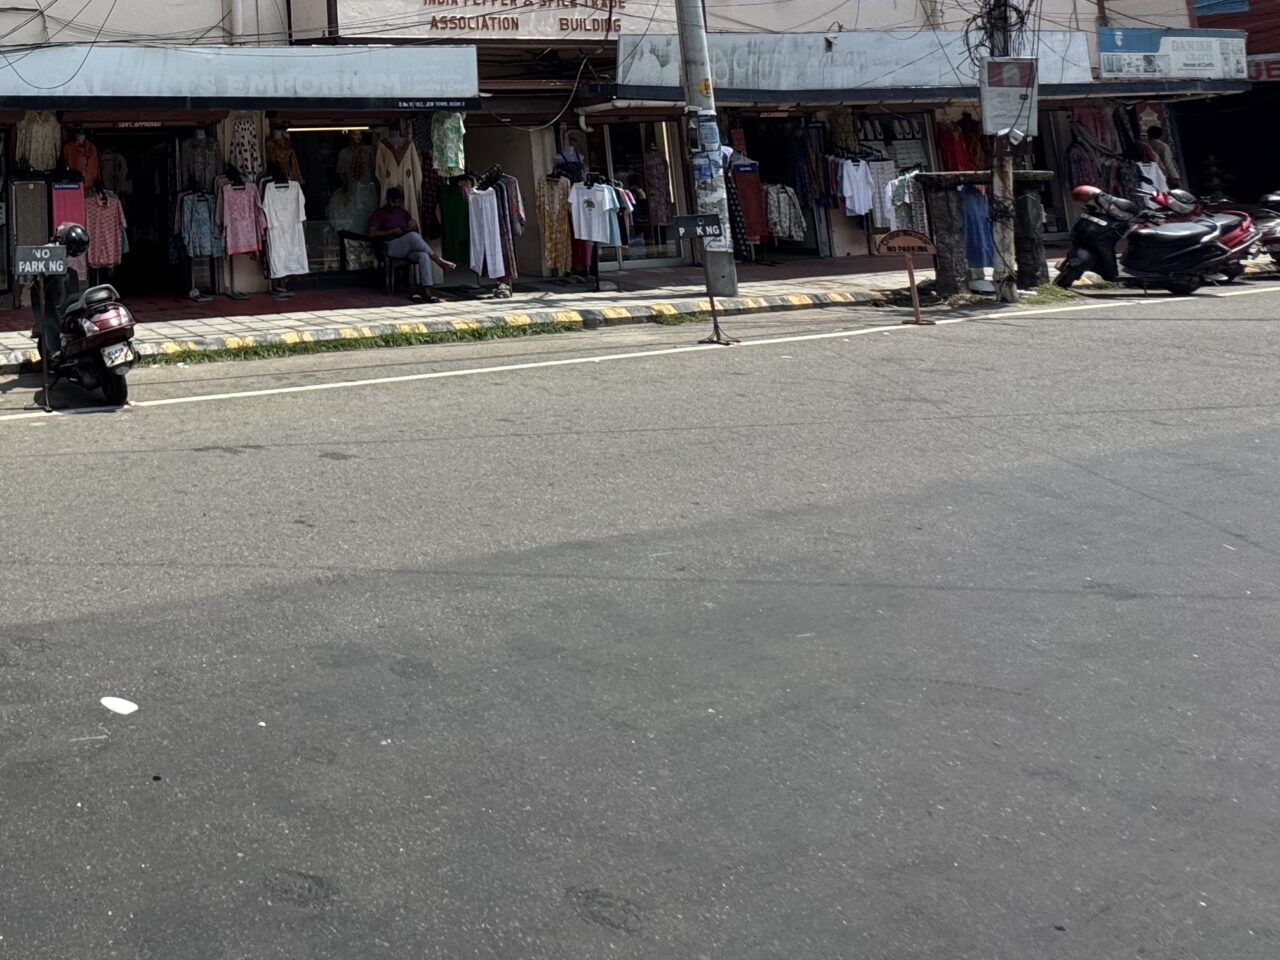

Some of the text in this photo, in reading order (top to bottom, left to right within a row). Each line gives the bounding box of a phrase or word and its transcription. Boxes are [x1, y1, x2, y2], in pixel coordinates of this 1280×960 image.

[430, 16, 621, 32] ASSOCIATION BUILDING
[678, 225, 720, 237] PKNG
[32, 249, 51, 258] NO
[18, 260, 64, 273] PARKNG
